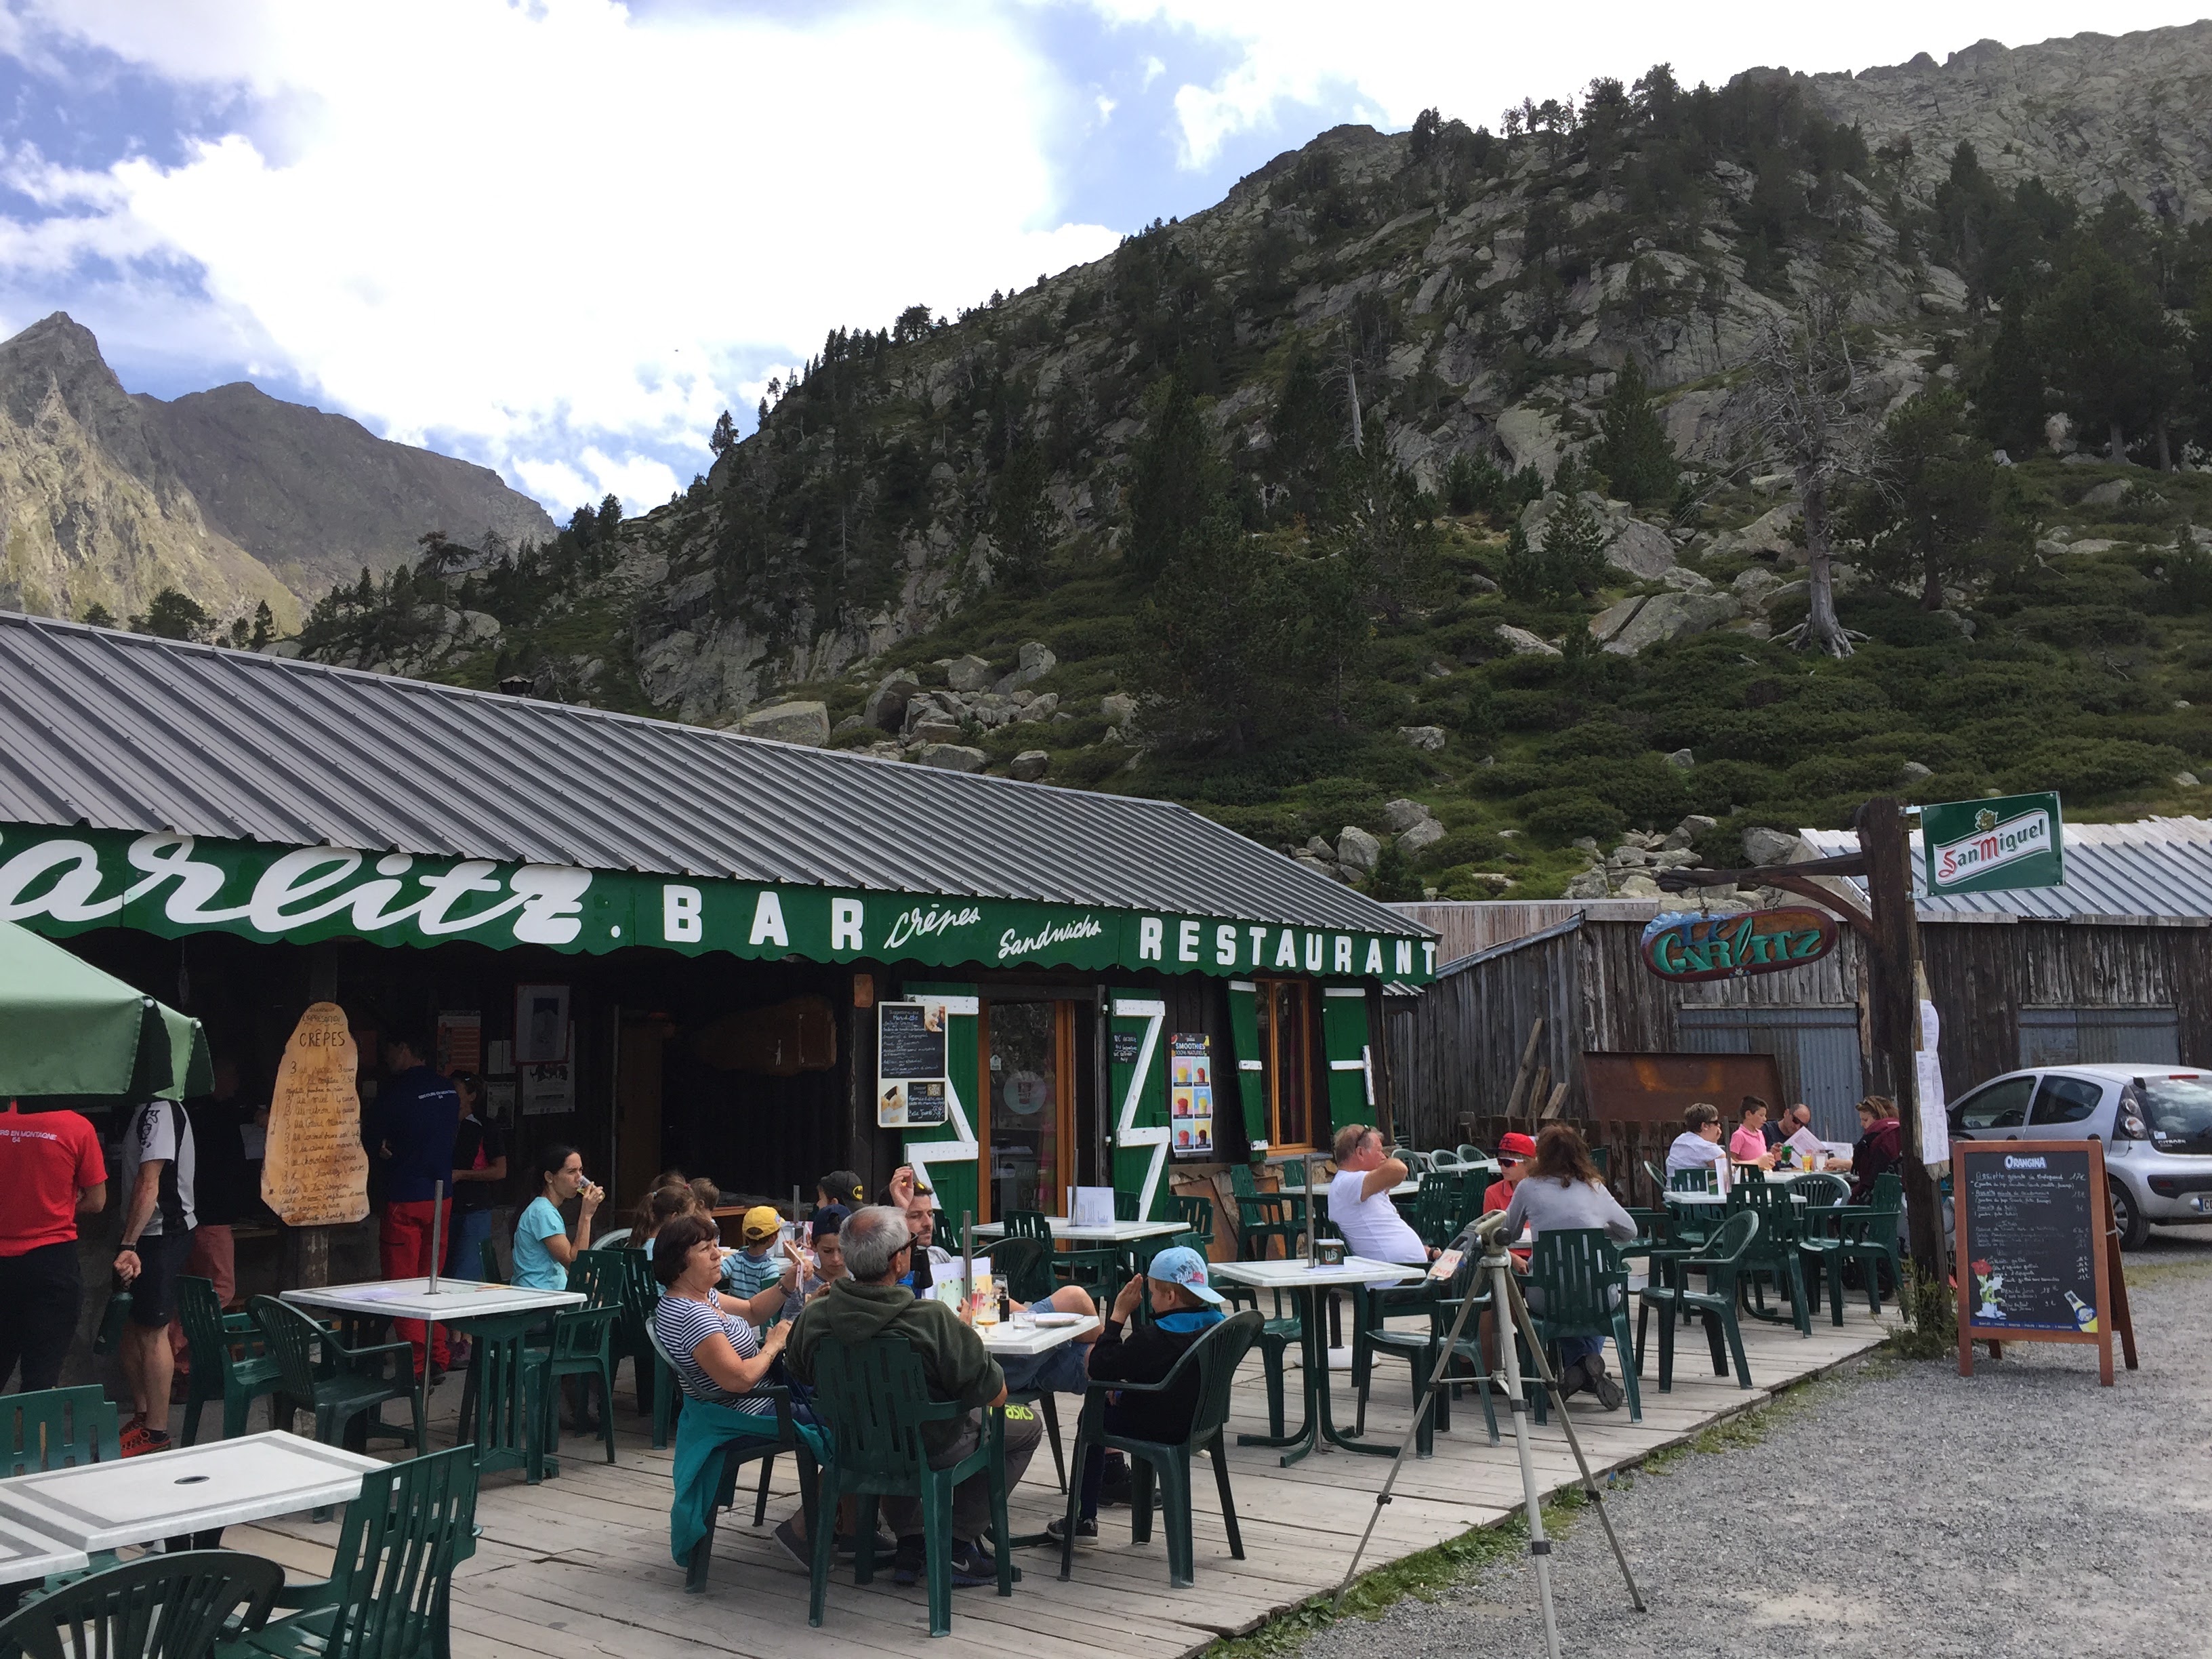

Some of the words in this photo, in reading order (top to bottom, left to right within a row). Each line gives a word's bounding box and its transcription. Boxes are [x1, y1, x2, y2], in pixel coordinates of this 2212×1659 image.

[663, 884, 863, 950] BAR
[998, 914, 1101, 959] Sandwichs
[1139, 916, 1435, 975] RESTAURANT
[300, 1028, 346, 1047] CRÊPES
[20, 1130, 58, 1140] MONTAGNE
[1005, 1404, 1034, 1420] asics
